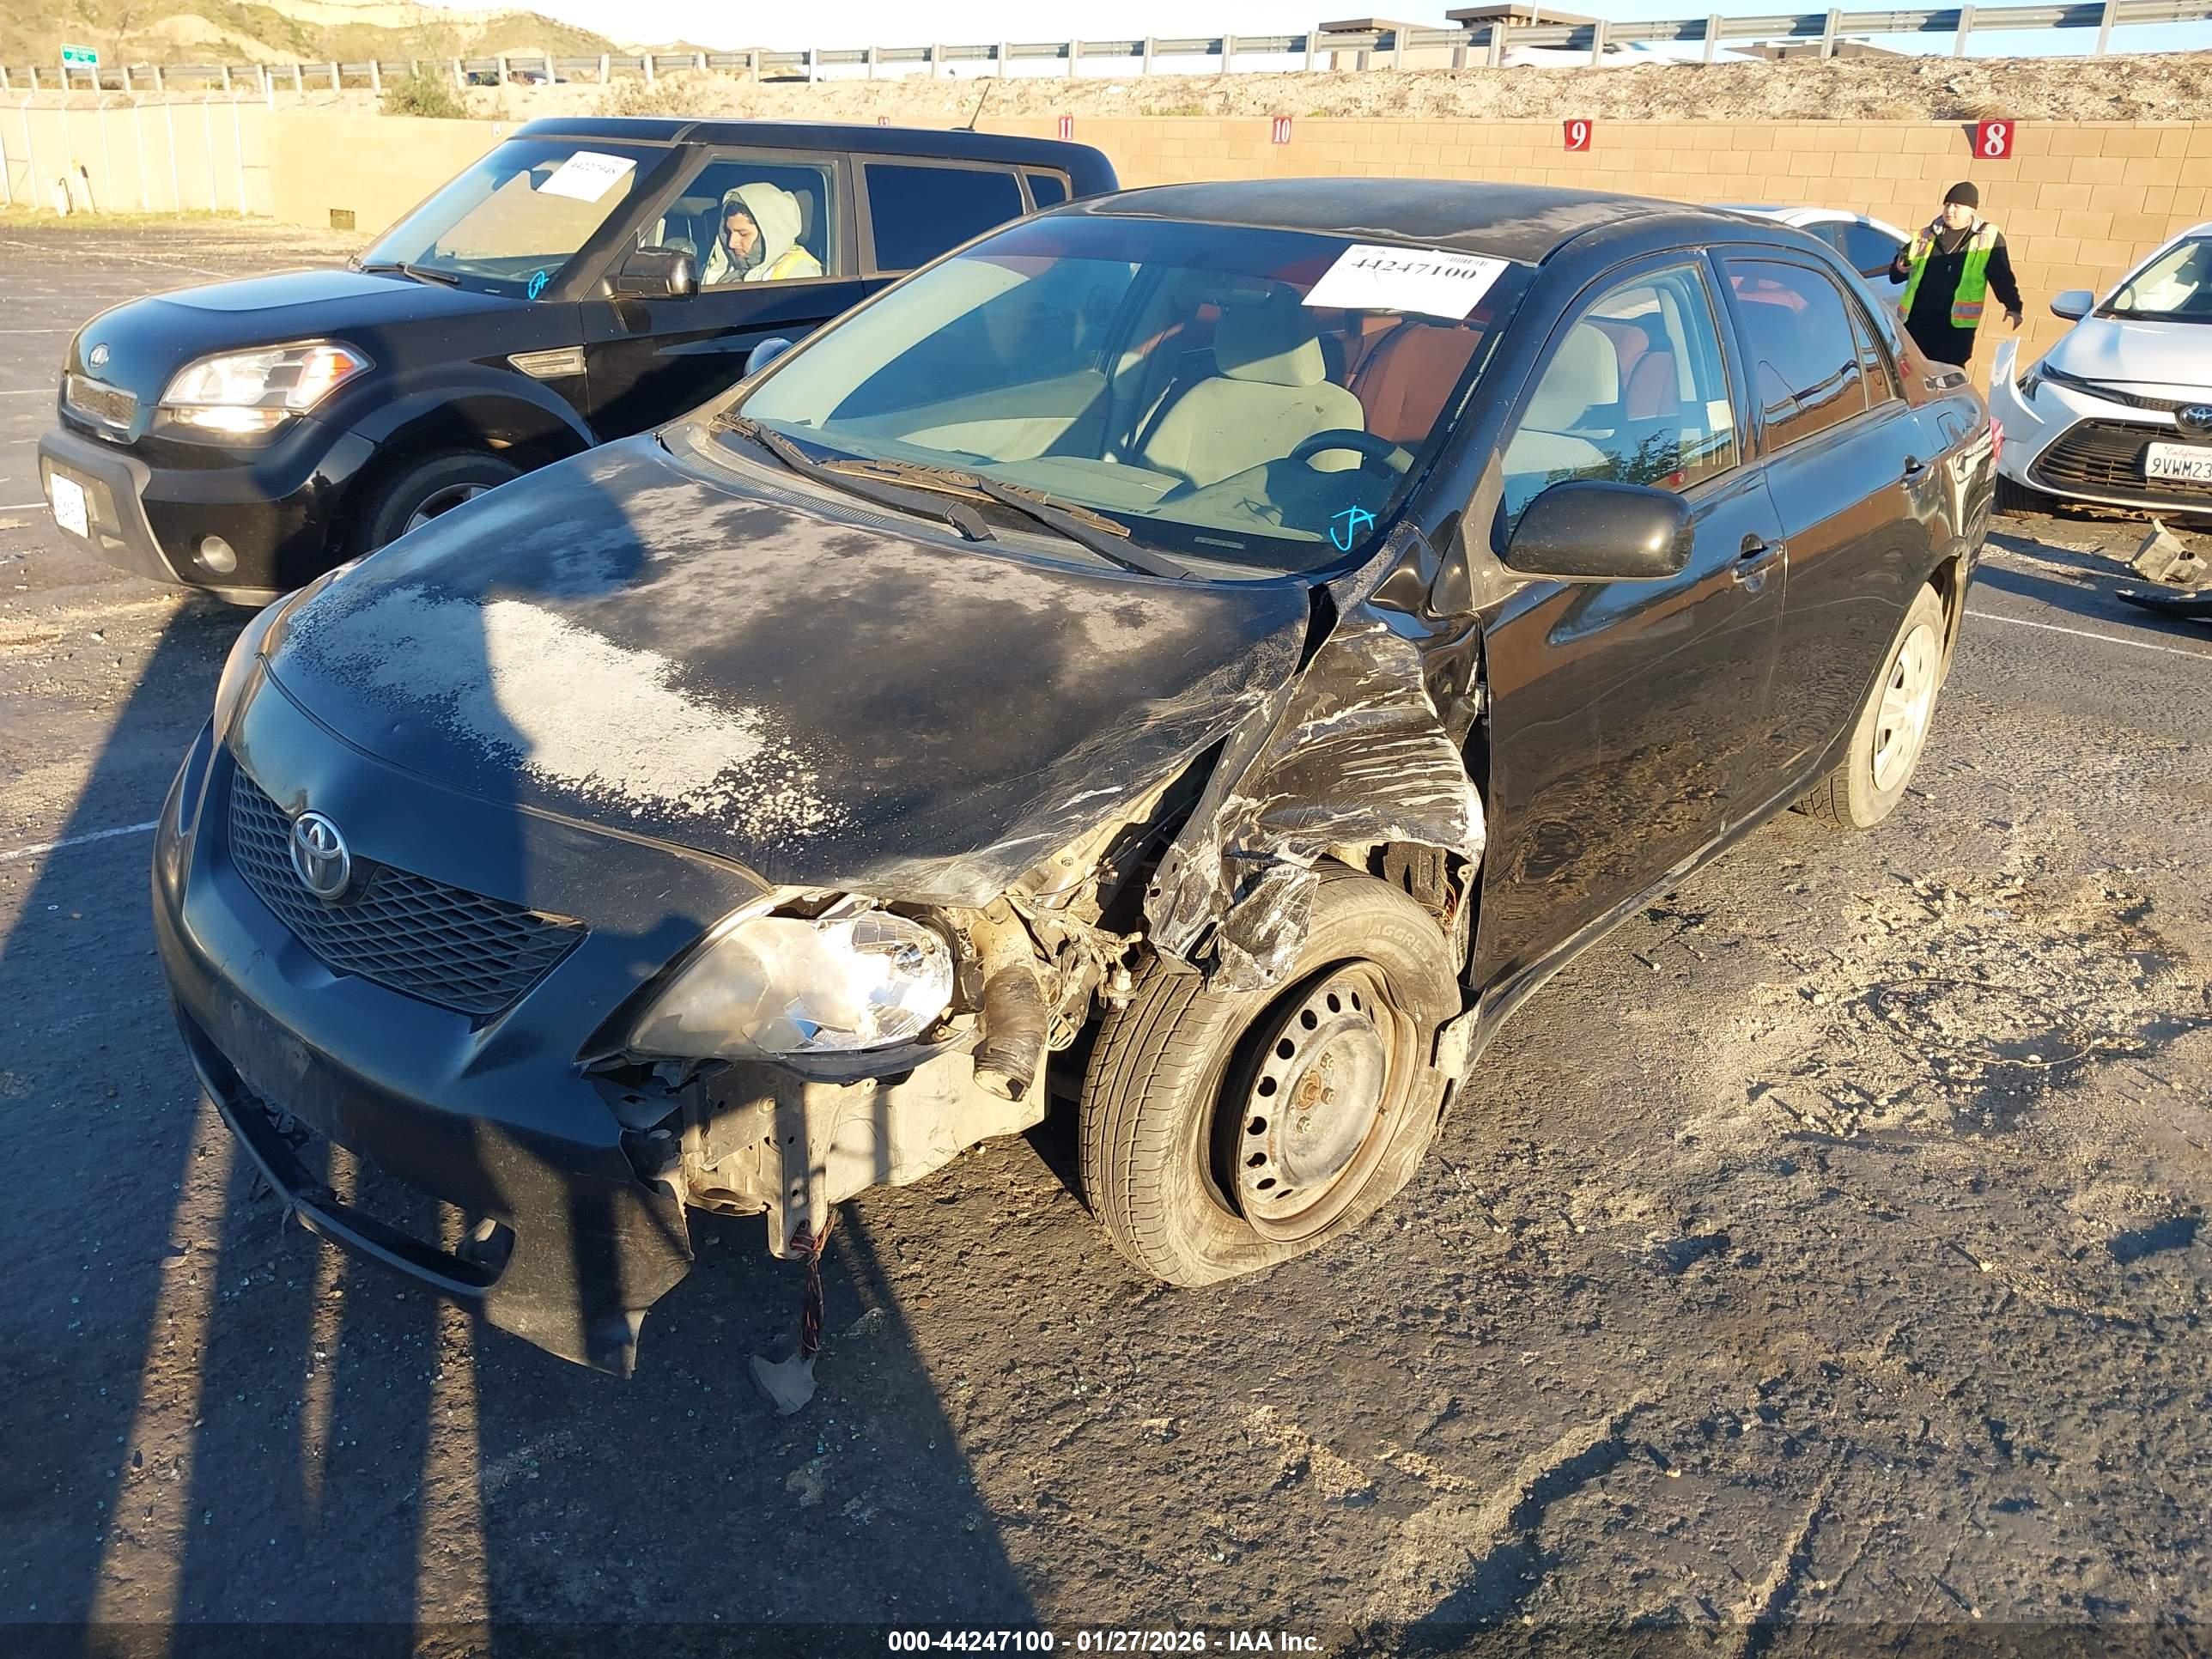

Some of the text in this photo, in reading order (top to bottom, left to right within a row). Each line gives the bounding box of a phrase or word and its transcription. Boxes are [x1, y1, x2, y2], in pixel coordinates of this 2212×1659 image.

[1060, 118, 1073, 139] 11
[1274, 118, 1291, 143] 10
[1571, 122, 1587, 149] 9
[1984, 123, 2006, 155] 8
[1351, 258, 1477, 280] 44247100
